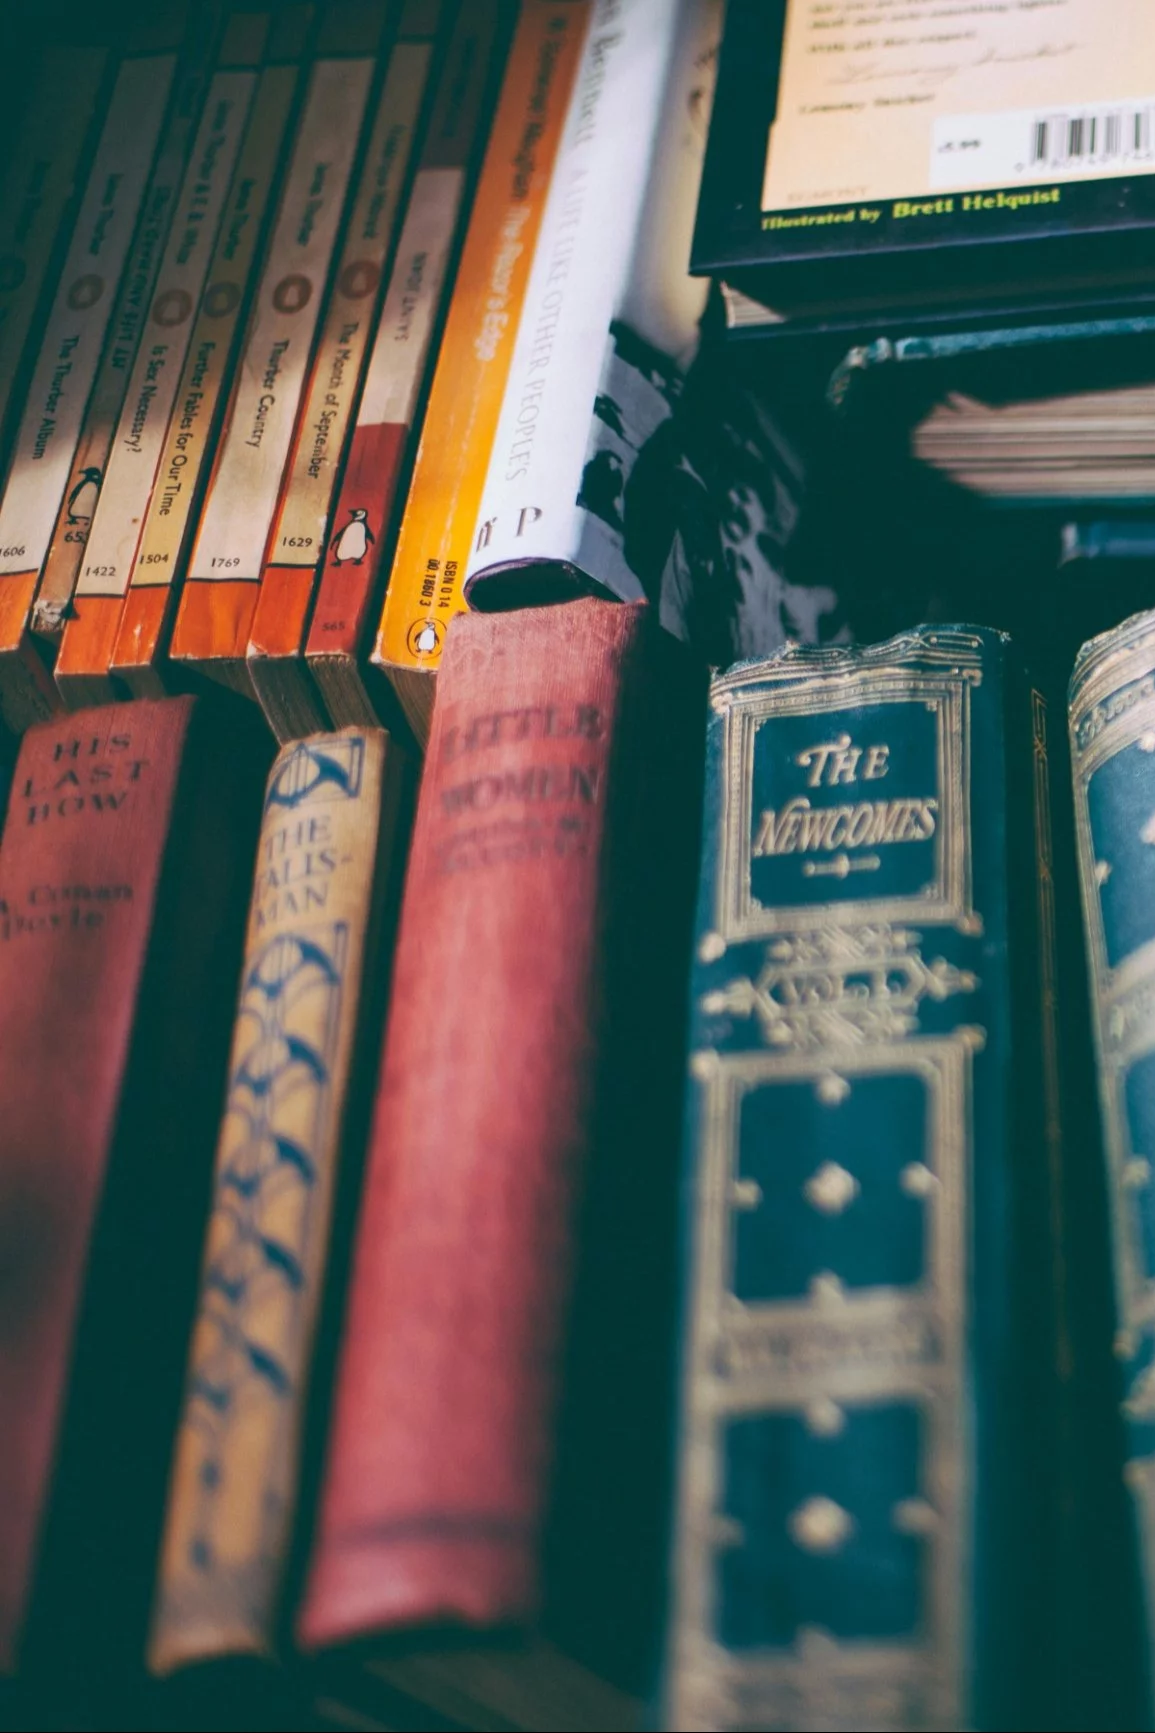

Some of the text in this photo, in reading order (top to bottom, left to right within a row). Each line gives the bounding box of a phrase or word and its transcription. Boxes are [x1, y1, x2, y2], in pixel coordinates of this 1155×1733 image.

[503, 206, 531, 240] The
[559, 184, 588, 230] LIFE
[761, 189, 1061, 231] Illustrated by Brett Helquist
[546, 236, 575, 288] LIKE
[341, 321, 360, 347] The
[474, 312, 509, 361] Edge
[528, 290, 564, 375] OTHER
[328, 348, 354, 391] Month
[33, 336, 80, 460] The Thurber Album
[125, 345, 169, 454] Is Sex Necessary?
[244, 339, 290, 449] Thurber Country
[325, 393, 341, 408] of
[159, 341, 216, 517] Further Fables for Our Time
[505, 379, 546, 481] PEOPLE'S
[139, 553, 170, 566] 1504
[210, 556, 241, 568] 1769
[281, 536, 313, 548] 1629
[85, 565, 117, 578] 1422
[444, 561, 458, 585] ISBN
[438, 597, 451, 608] 14
[53, 734, 132, 762] HIS
[796, 734, 890, 787] THE
[753, 796, 939, 857] NEWCOMES
